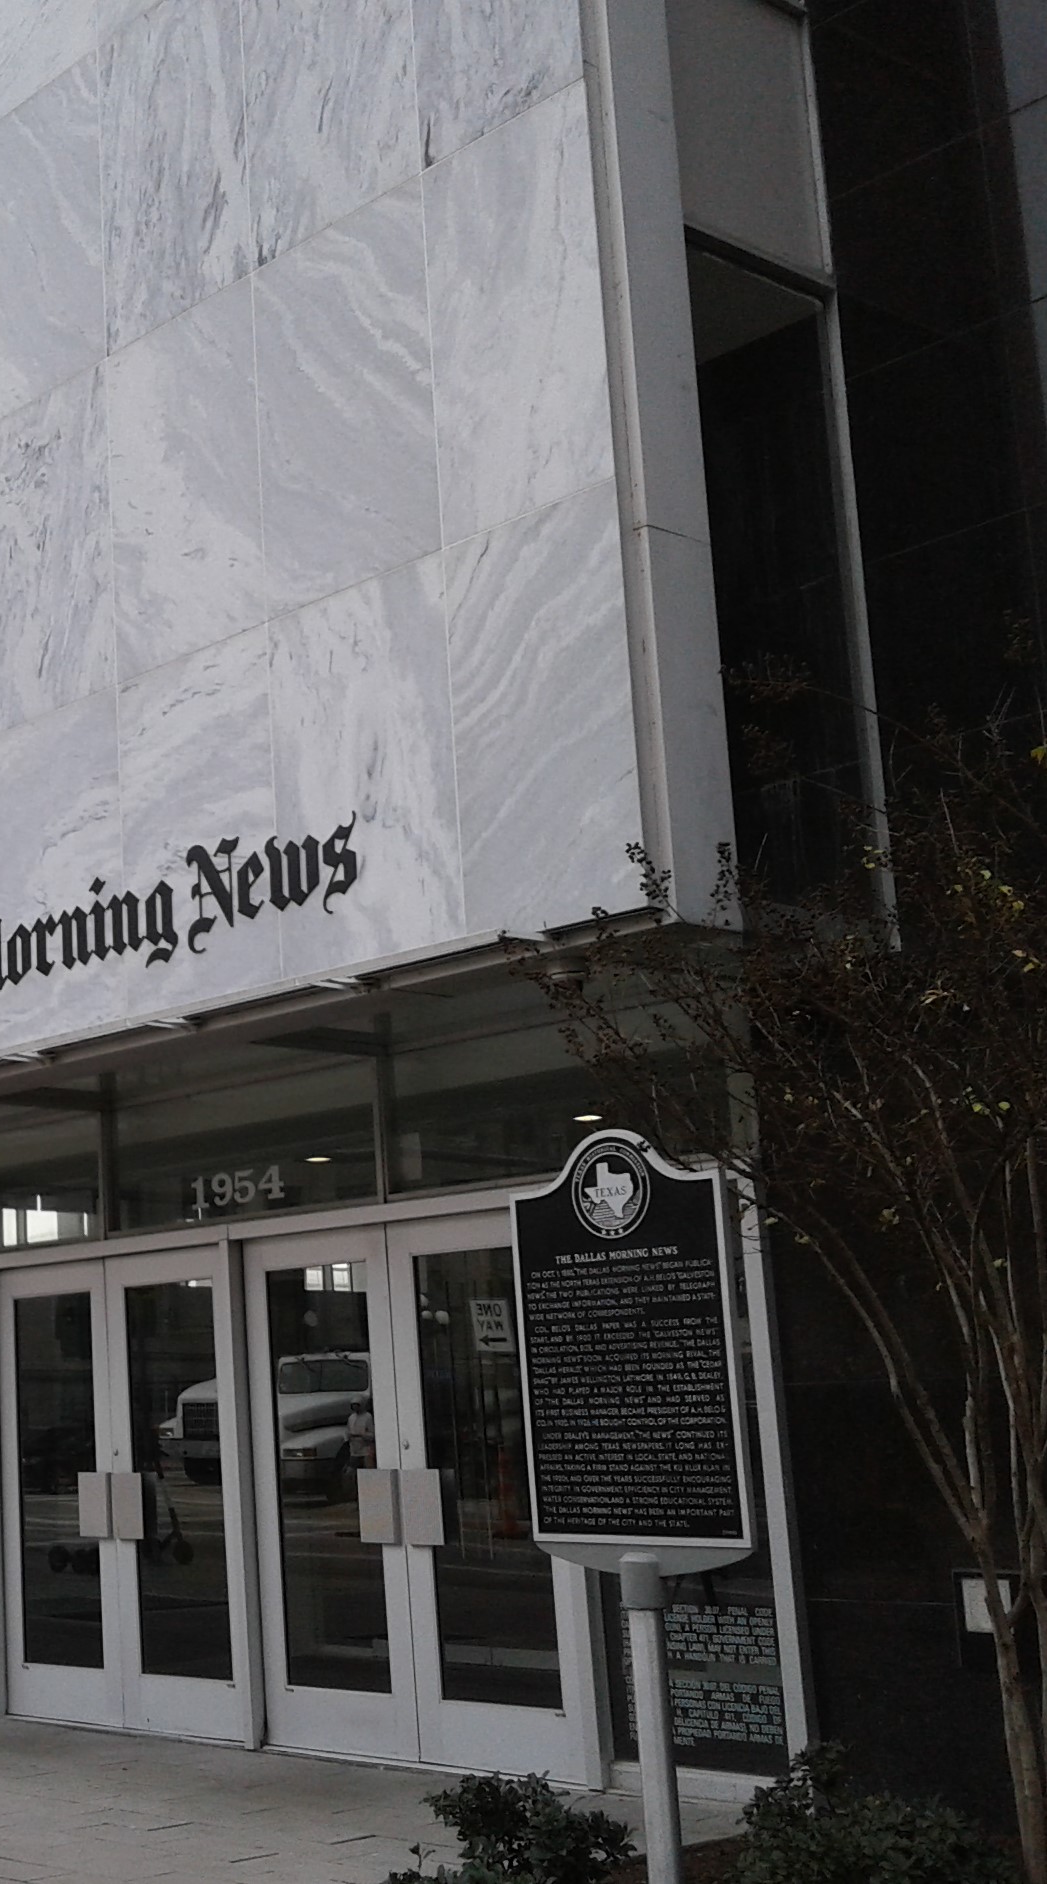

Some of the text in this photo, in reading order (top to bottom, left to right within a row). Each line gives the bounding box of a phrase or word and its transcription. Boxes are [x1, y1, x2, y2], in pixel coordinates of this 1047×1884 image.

[186, 810, 357, 953] News
[191, 1165, 285, 1210] 1954
[594, 1186, 627, 1198] TEXAS
[555, 1246, 678, 1264] THE DALLAS MORNING NEWS
[588, 1266, 610, 1274] DALLAS
[575, 1323, 597, 1331] DALLAS
[562, 1397, 584, 1405] DALLAS
